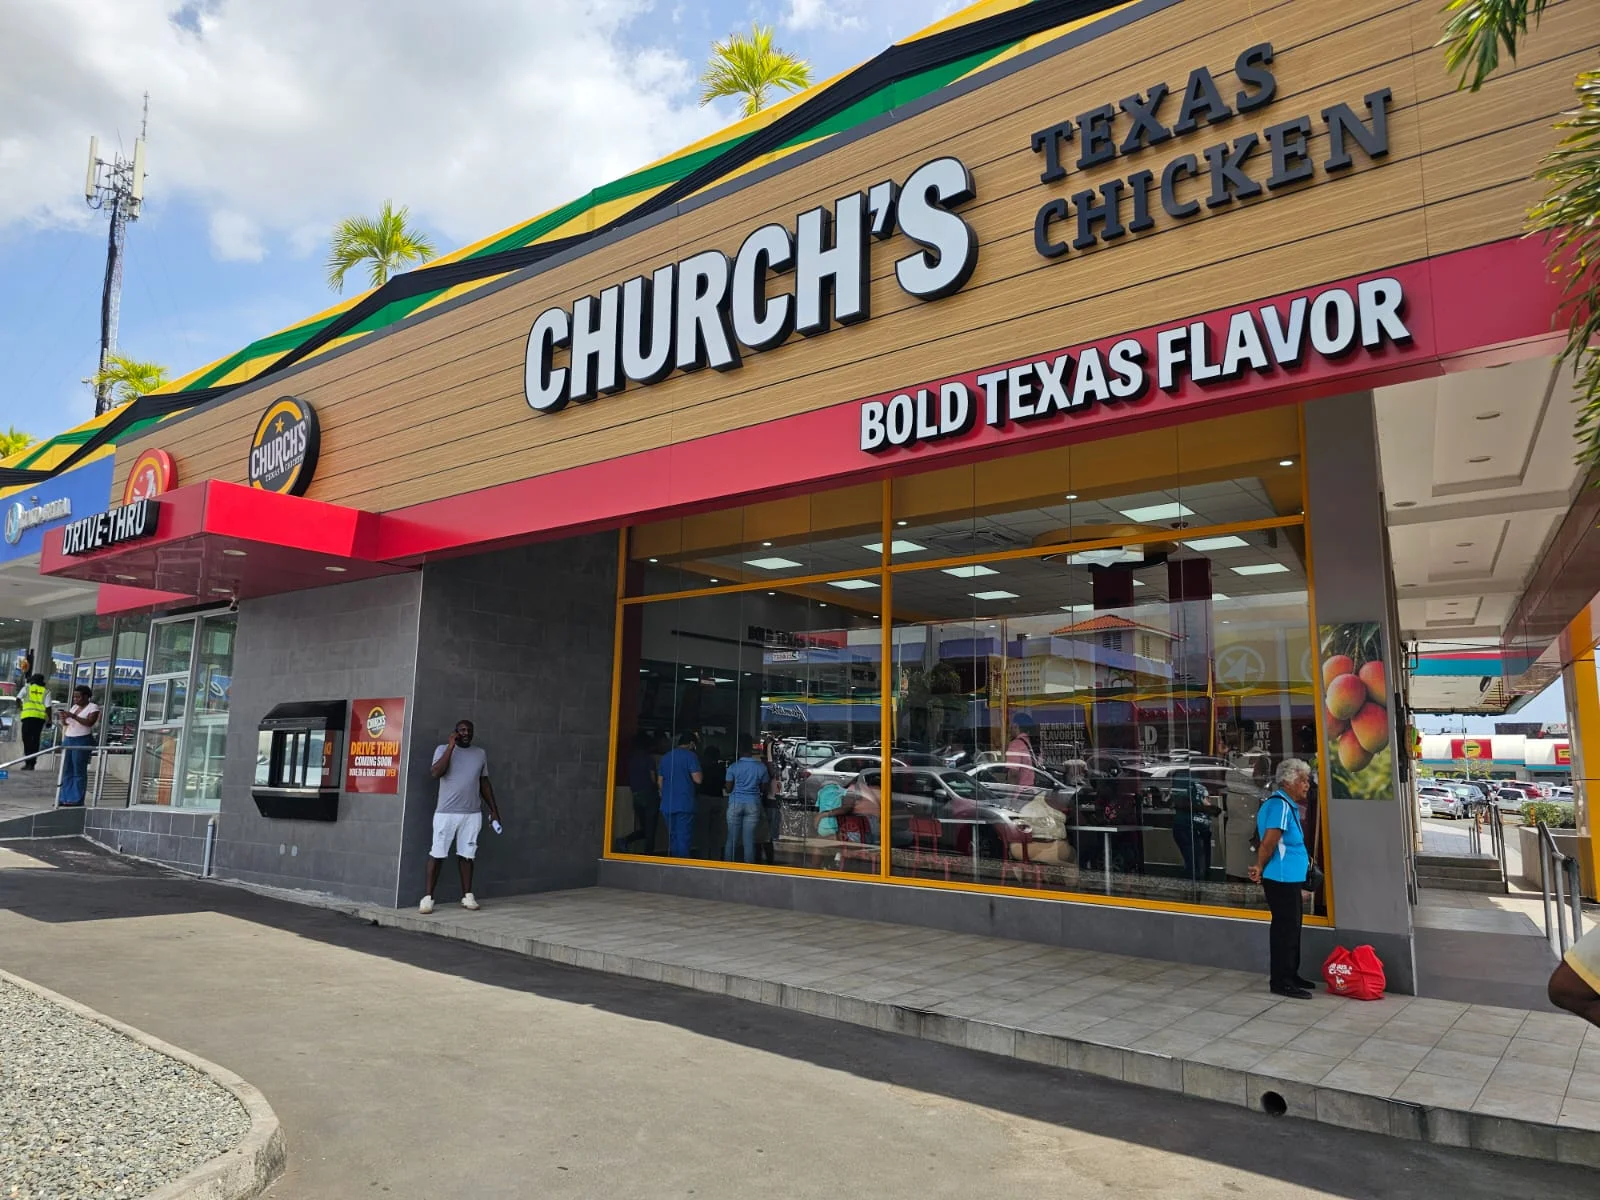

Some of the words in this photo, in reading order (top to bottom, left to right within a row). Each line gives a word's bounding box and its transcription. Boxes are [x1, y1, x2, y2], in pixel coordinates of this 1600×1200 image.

[1031, 42, 1277, 184] TEXAS
[1033, 87, 1393, 258] CHICKEN
[523, 156, 978, 413] CHURCH'S
[860, 380, 971, 452] BOLD
[978, 338, 1145, 426] TEXAS
[1156, 276, 1412, 389] FLAVOR
[250, 421, 306, 479] CHURCH'S
[62, 500, 147, 555] DRIVE-THRU
[351, 742, 375, 755] DRIVE
[376, 741, 399, 755] THRU
[355, 757, 376, 766] COMING
[377, 757, 393, 766] SOON
[1040, 731, 1085, 741] FLAVORFUL
